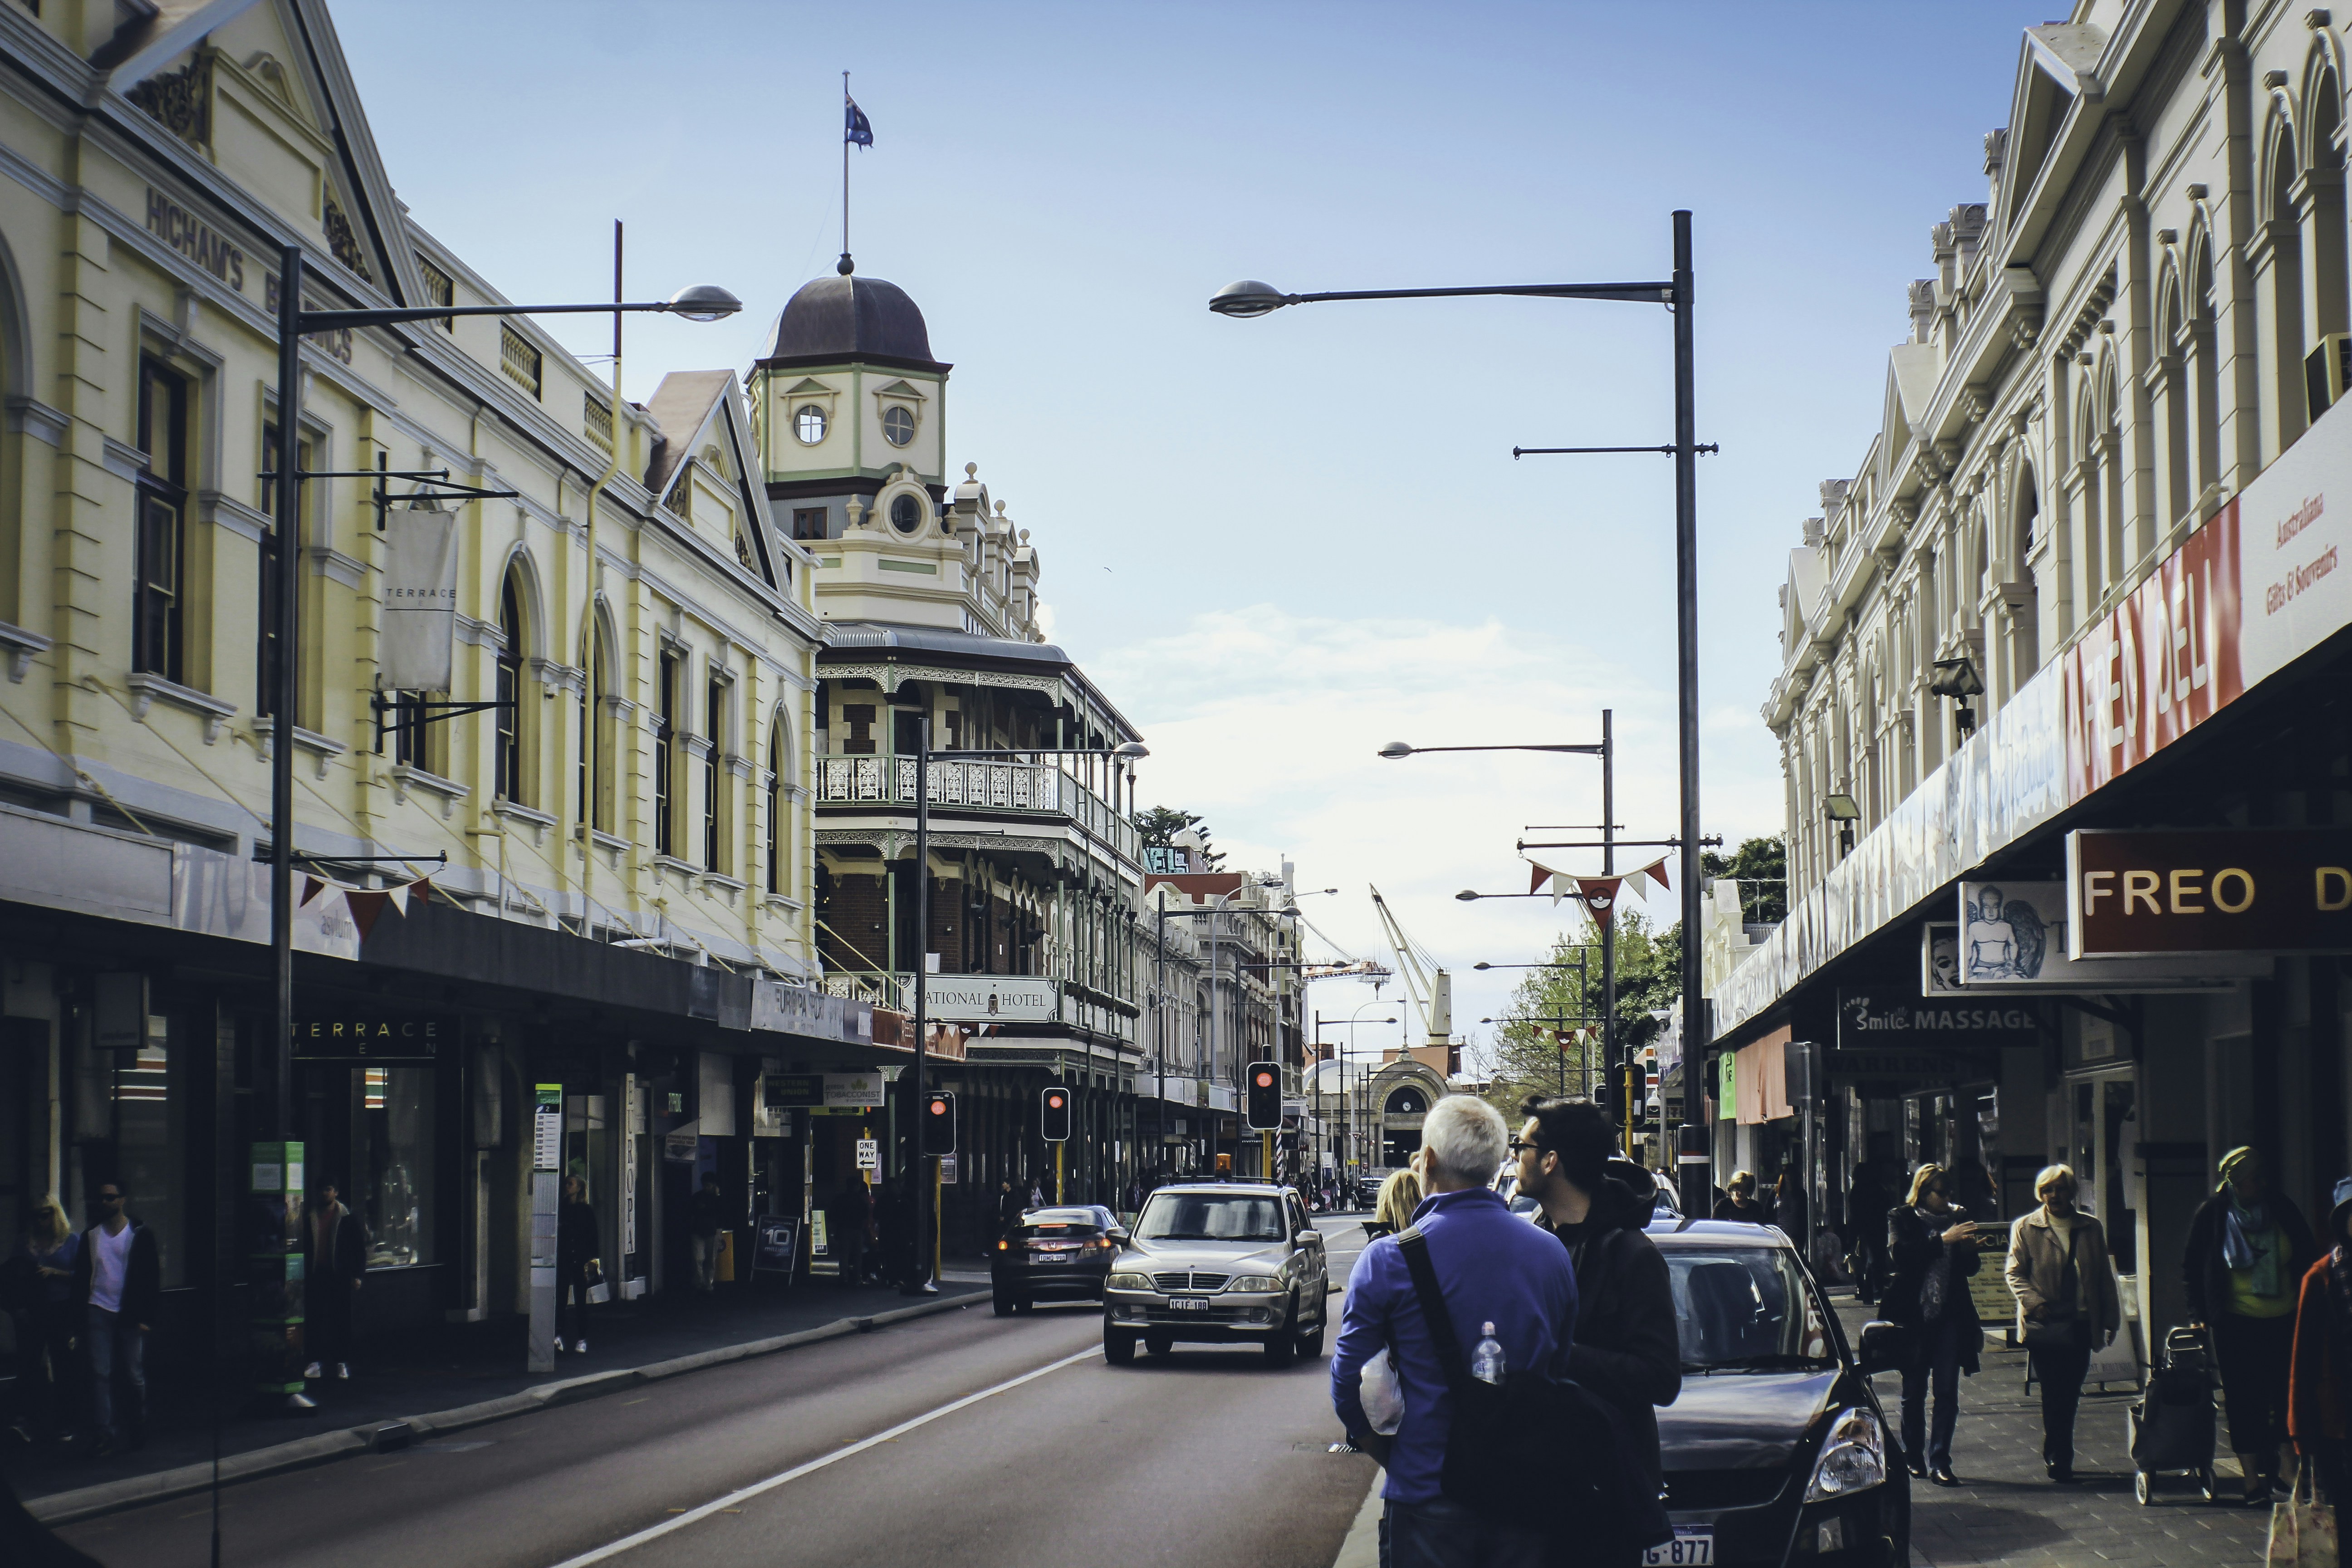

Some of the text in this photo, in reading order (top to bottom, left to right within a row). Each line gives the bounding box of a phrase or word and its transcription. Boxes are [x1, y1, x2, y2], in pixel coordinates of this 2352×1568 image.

[386, 588, 456, 598] TERRACE
[2084, 558, 2214, 767] FREO DELI
[2084, 867, 2255, 916] FREO
[1002, 992, 1046, 1007] HOTEL
[1915, 1010, 2036, 1030] MASSAGE
[290, 1022, 436, 1037] TERRACE
[1823, 1056, 1957, 1073] WARRENS
[824, 1091, 880, 1100] TOBACCONIST
[1976, 1234, 2010, 1247] ECIA
